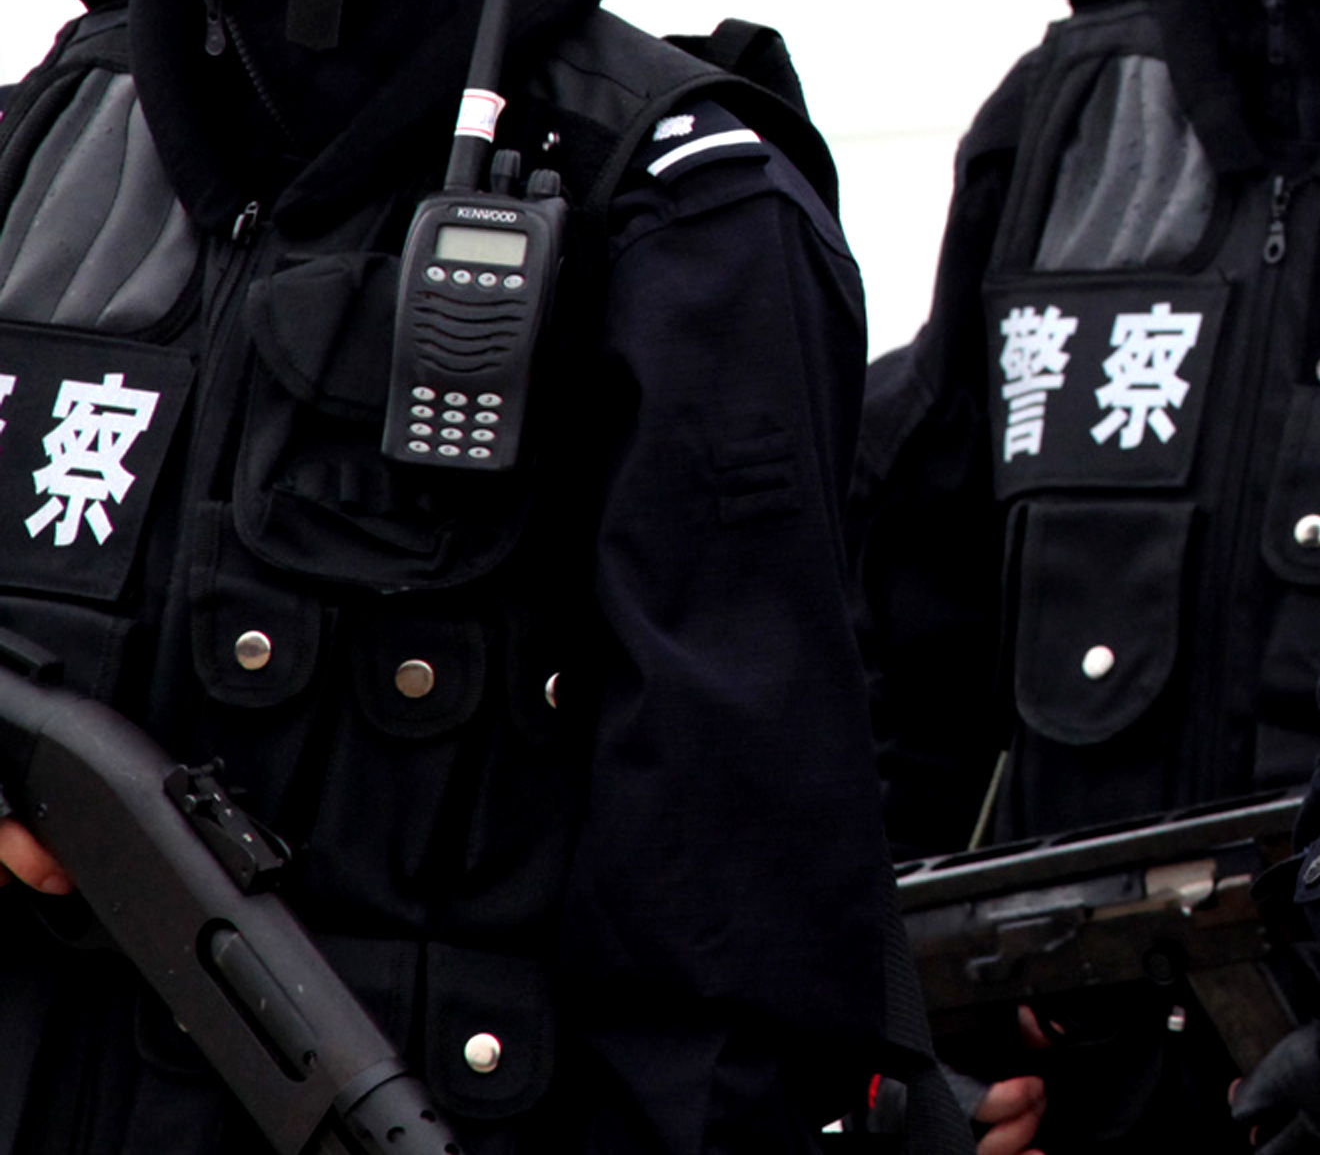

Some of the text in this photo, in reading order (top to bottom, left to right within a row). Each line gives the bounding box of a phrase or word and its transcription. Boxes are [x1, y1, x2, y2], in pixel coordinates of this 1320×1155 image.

[457, 207, 517, 223] KENWOOD
[0, 373, 160, 546] 察
[1000, 303, 1203, 463] 警察
